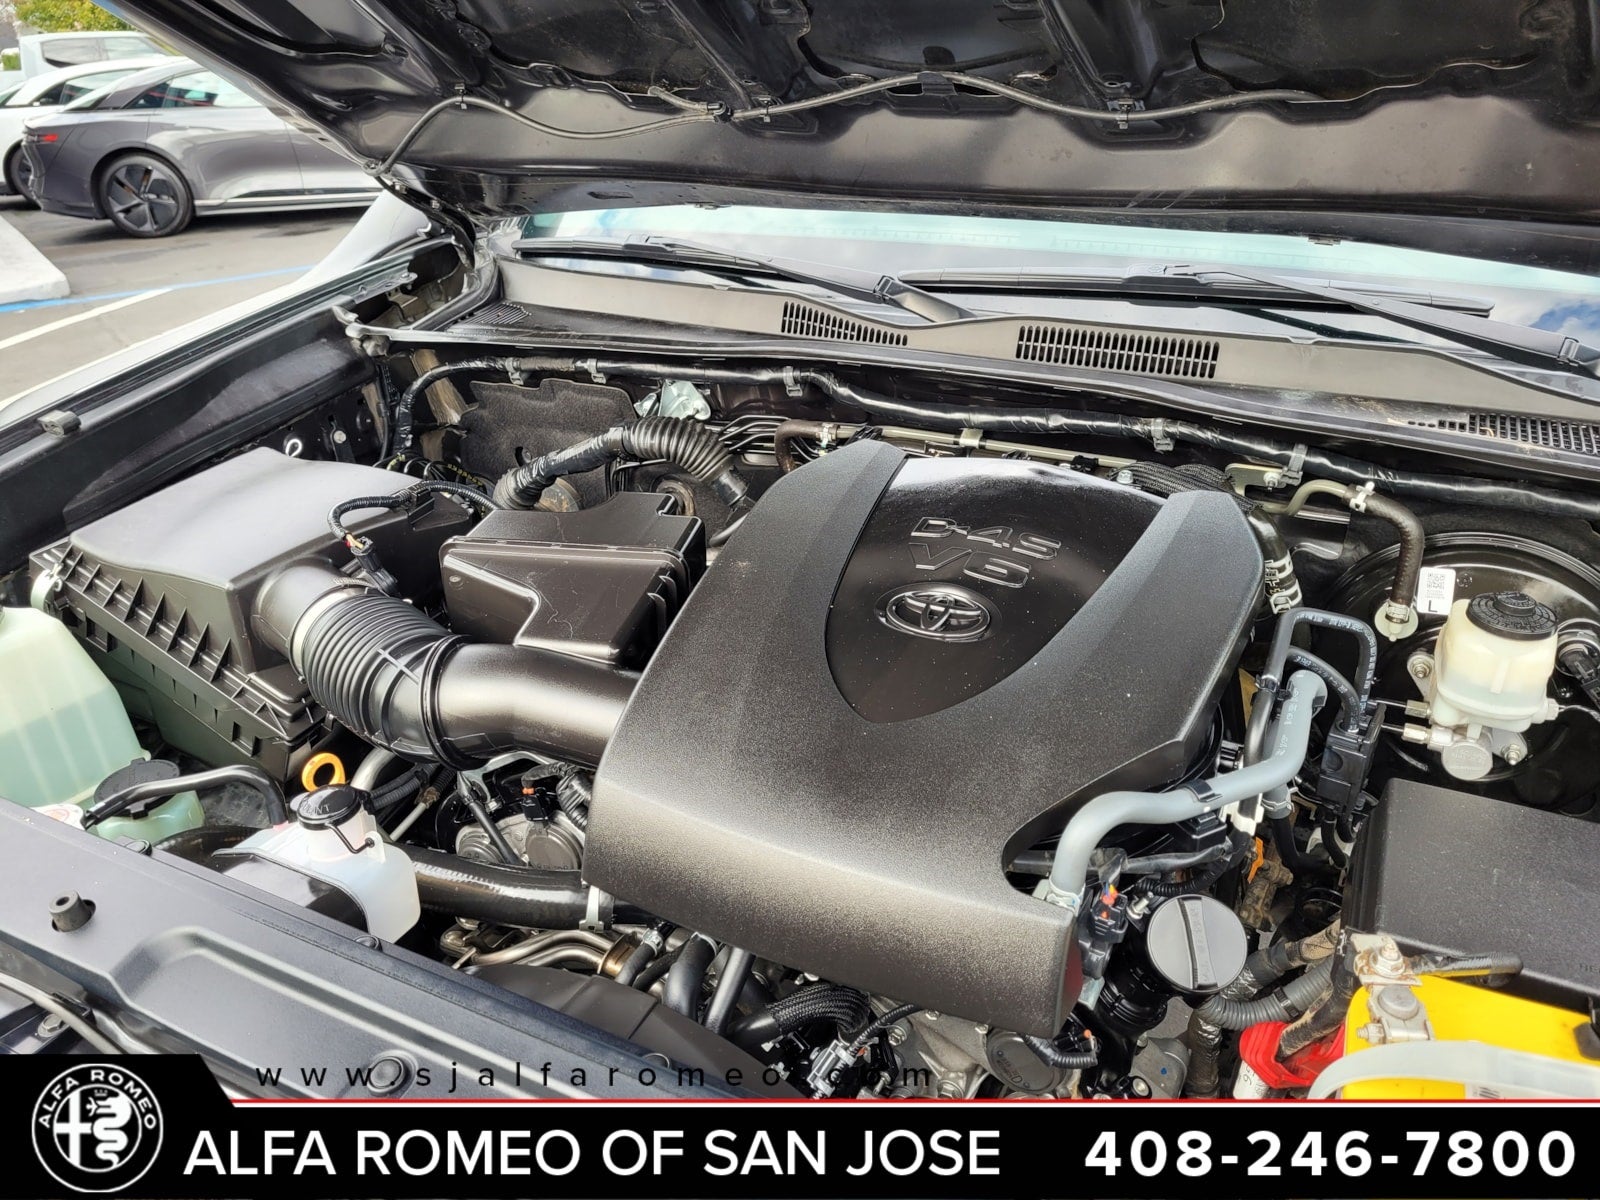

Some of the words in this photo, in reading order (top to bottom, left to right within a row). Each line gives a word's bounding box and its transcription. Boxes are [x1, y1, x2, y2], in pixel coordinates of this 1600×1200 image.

[911, 516, 1062, 561] D-4S
[908, 542, 1032, 589] V6
[1427, 599, 1438, 613] L
